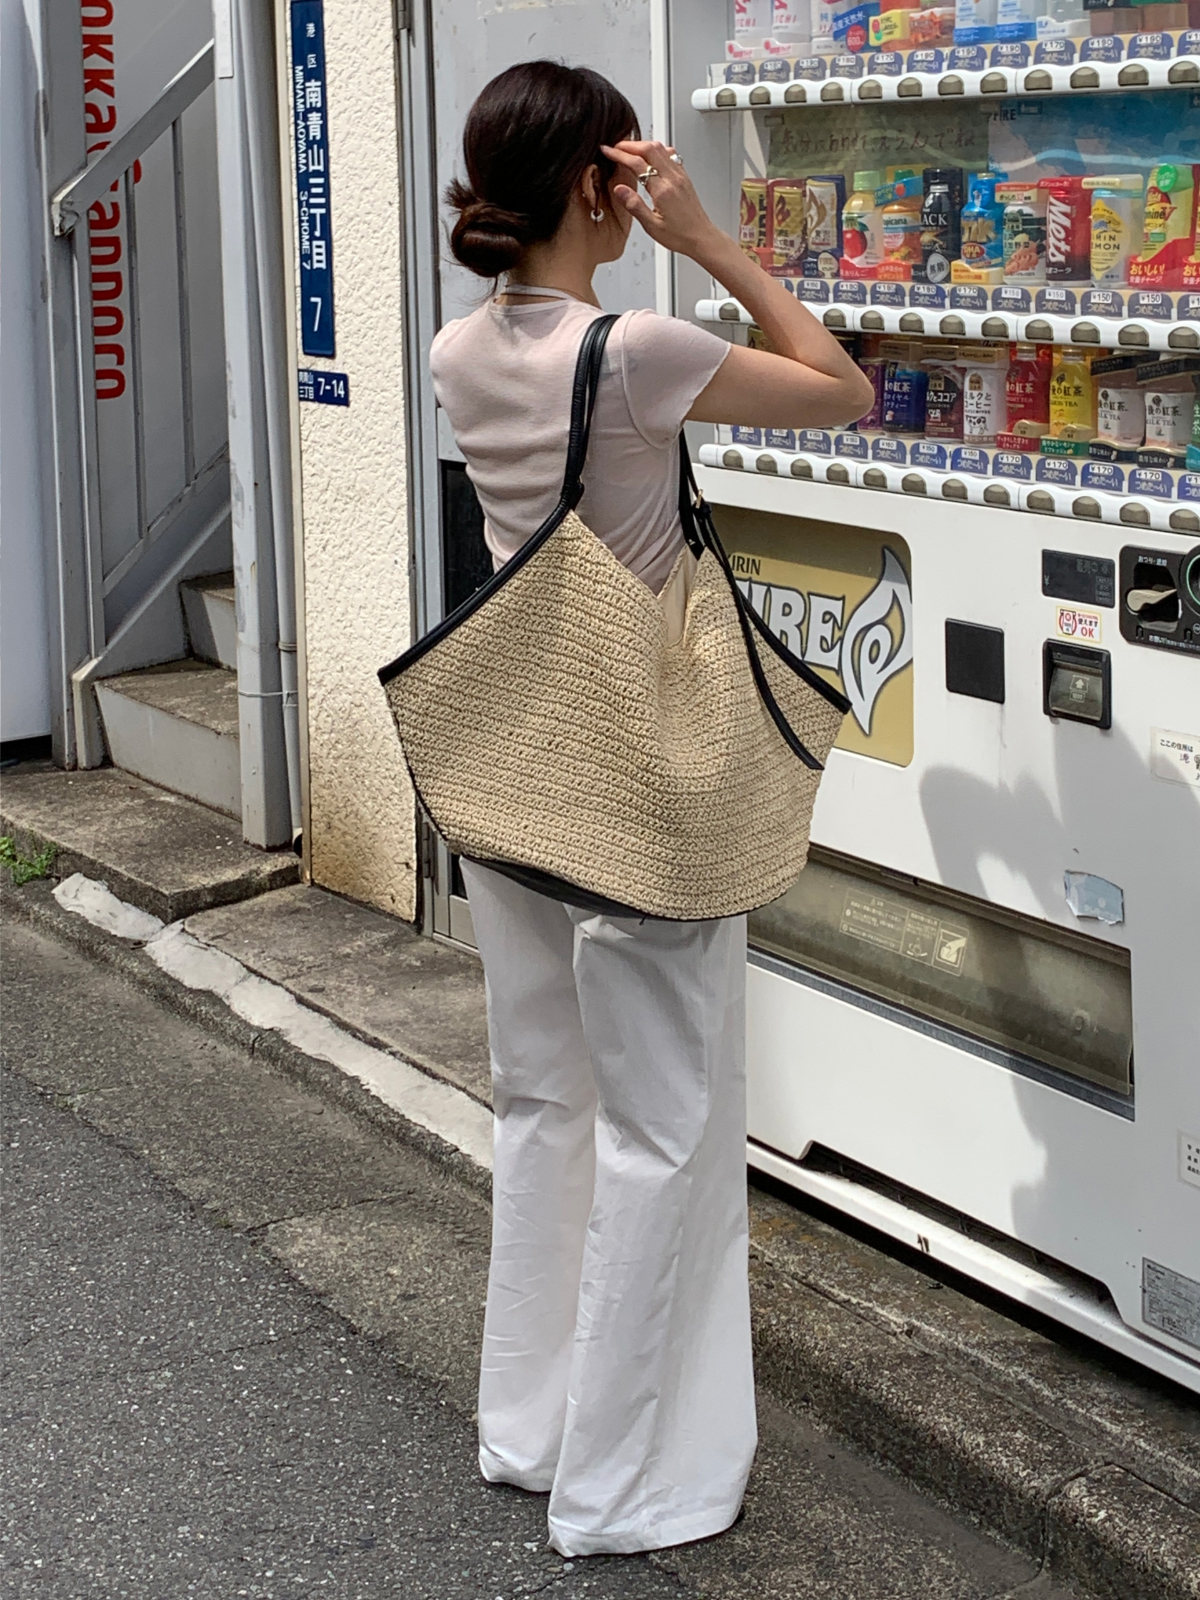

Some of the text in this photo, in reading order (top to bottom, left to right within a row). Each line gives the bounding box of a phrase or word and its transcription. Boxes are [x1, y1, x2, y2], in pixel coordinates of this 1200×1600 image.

[295, 65, 307, 173] MINAMI-AOYAMA
[300, 191, 310, 254] 3-CHOME
[1049, 195, 1071, 264] Mets
[1004, 289, 1020, 297] ¥150
[1092, 293, 1111, 302] ¥150
[1141, 295, 1161, 303] ¥150
[310, 297, 322, 332] 7
[299, 386, 314, 399] 三丁目
[317, 377, 345, 398] 7-14
[1000, 456, 1021, 464] ¥170
[1047, 461, 1067, 469] ¥170
[1091, 466, 1112, 474] ¥170
[1138, 471, 1160, 480] ¥170
[1081, 626, 1095, 638] OK
